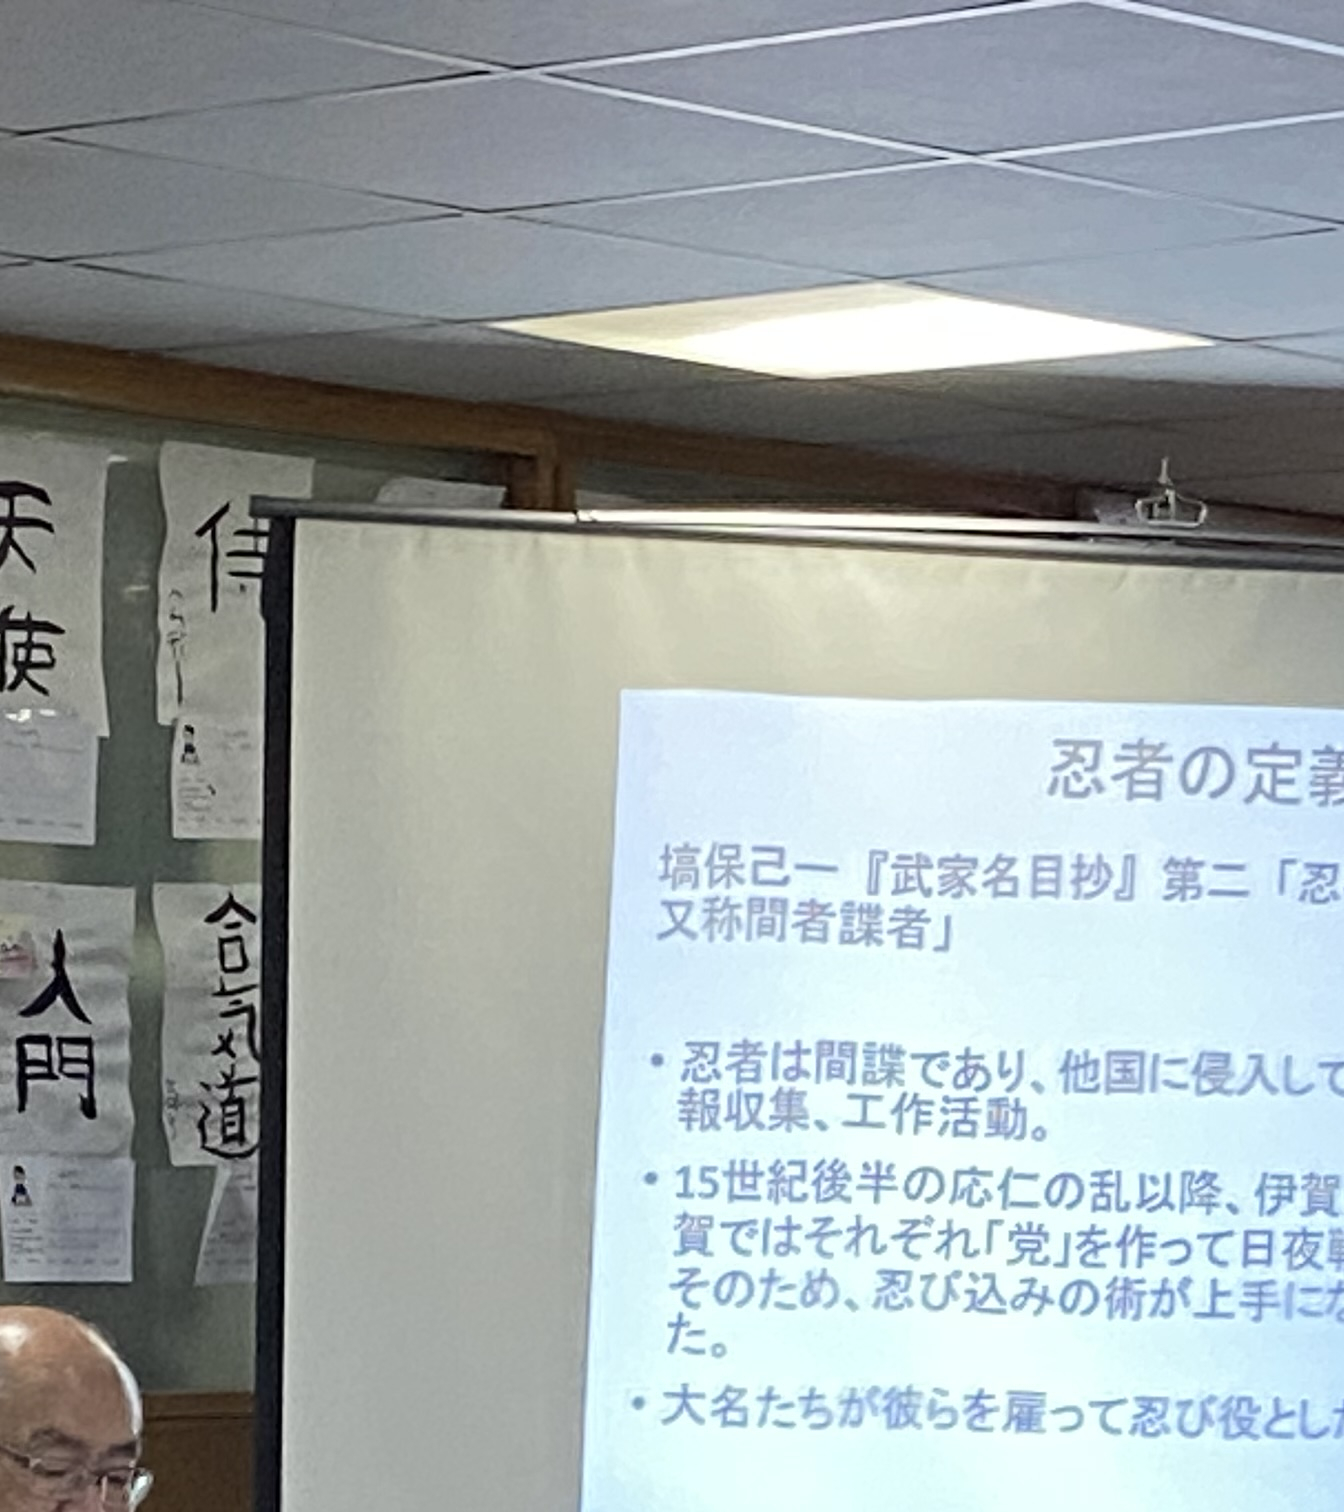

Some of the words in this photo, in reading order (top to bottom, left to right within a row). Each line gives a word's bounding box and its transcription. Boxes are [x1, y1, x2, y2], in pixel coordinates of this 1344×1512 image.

[656, 898, 954, 953] 又称間者諜者」
[677, 1086, 1050, 1142] 報収集、工作活動。
[665, 1313, 730, 1359] た。
